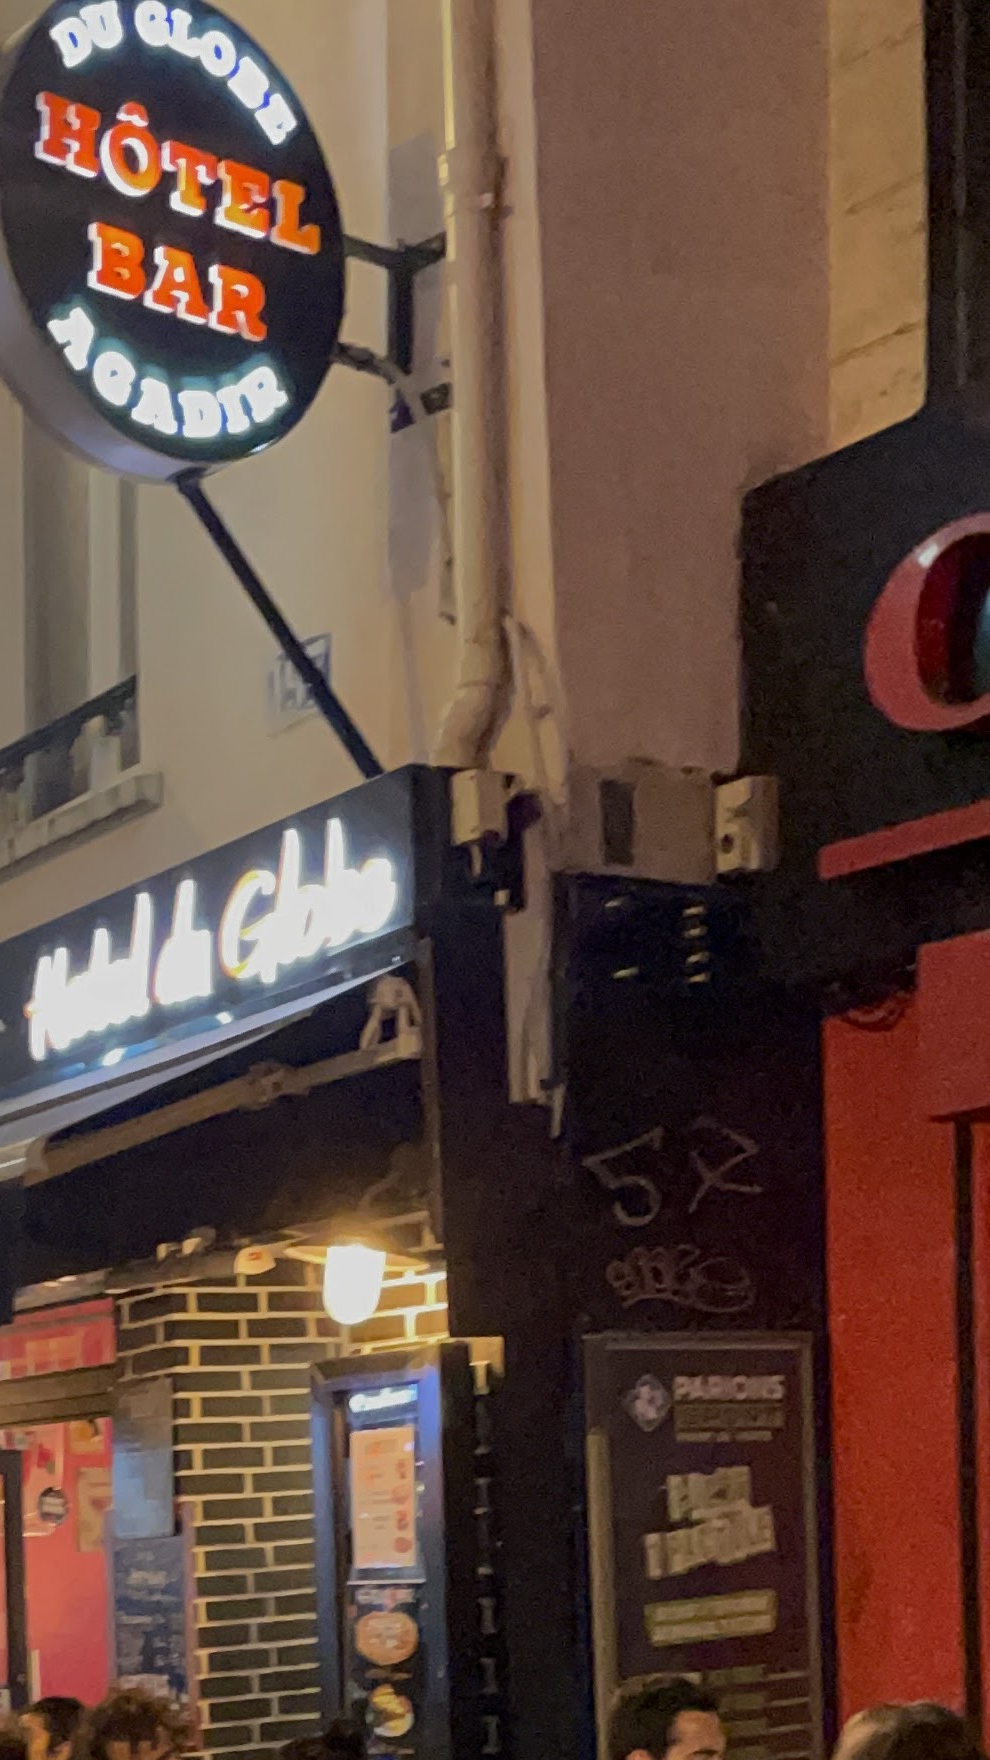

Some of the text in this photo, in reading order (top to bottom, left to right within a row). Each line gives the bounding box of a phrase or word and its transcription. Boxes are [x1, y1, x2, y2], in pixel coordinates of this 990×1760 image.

[49, 0, 297, 146] DU GLOBE
[34, 90, 322, 255] HÔTEL
[87, 221, 268, 342] BAR
[47, 306, 290, 438] AGADIR
